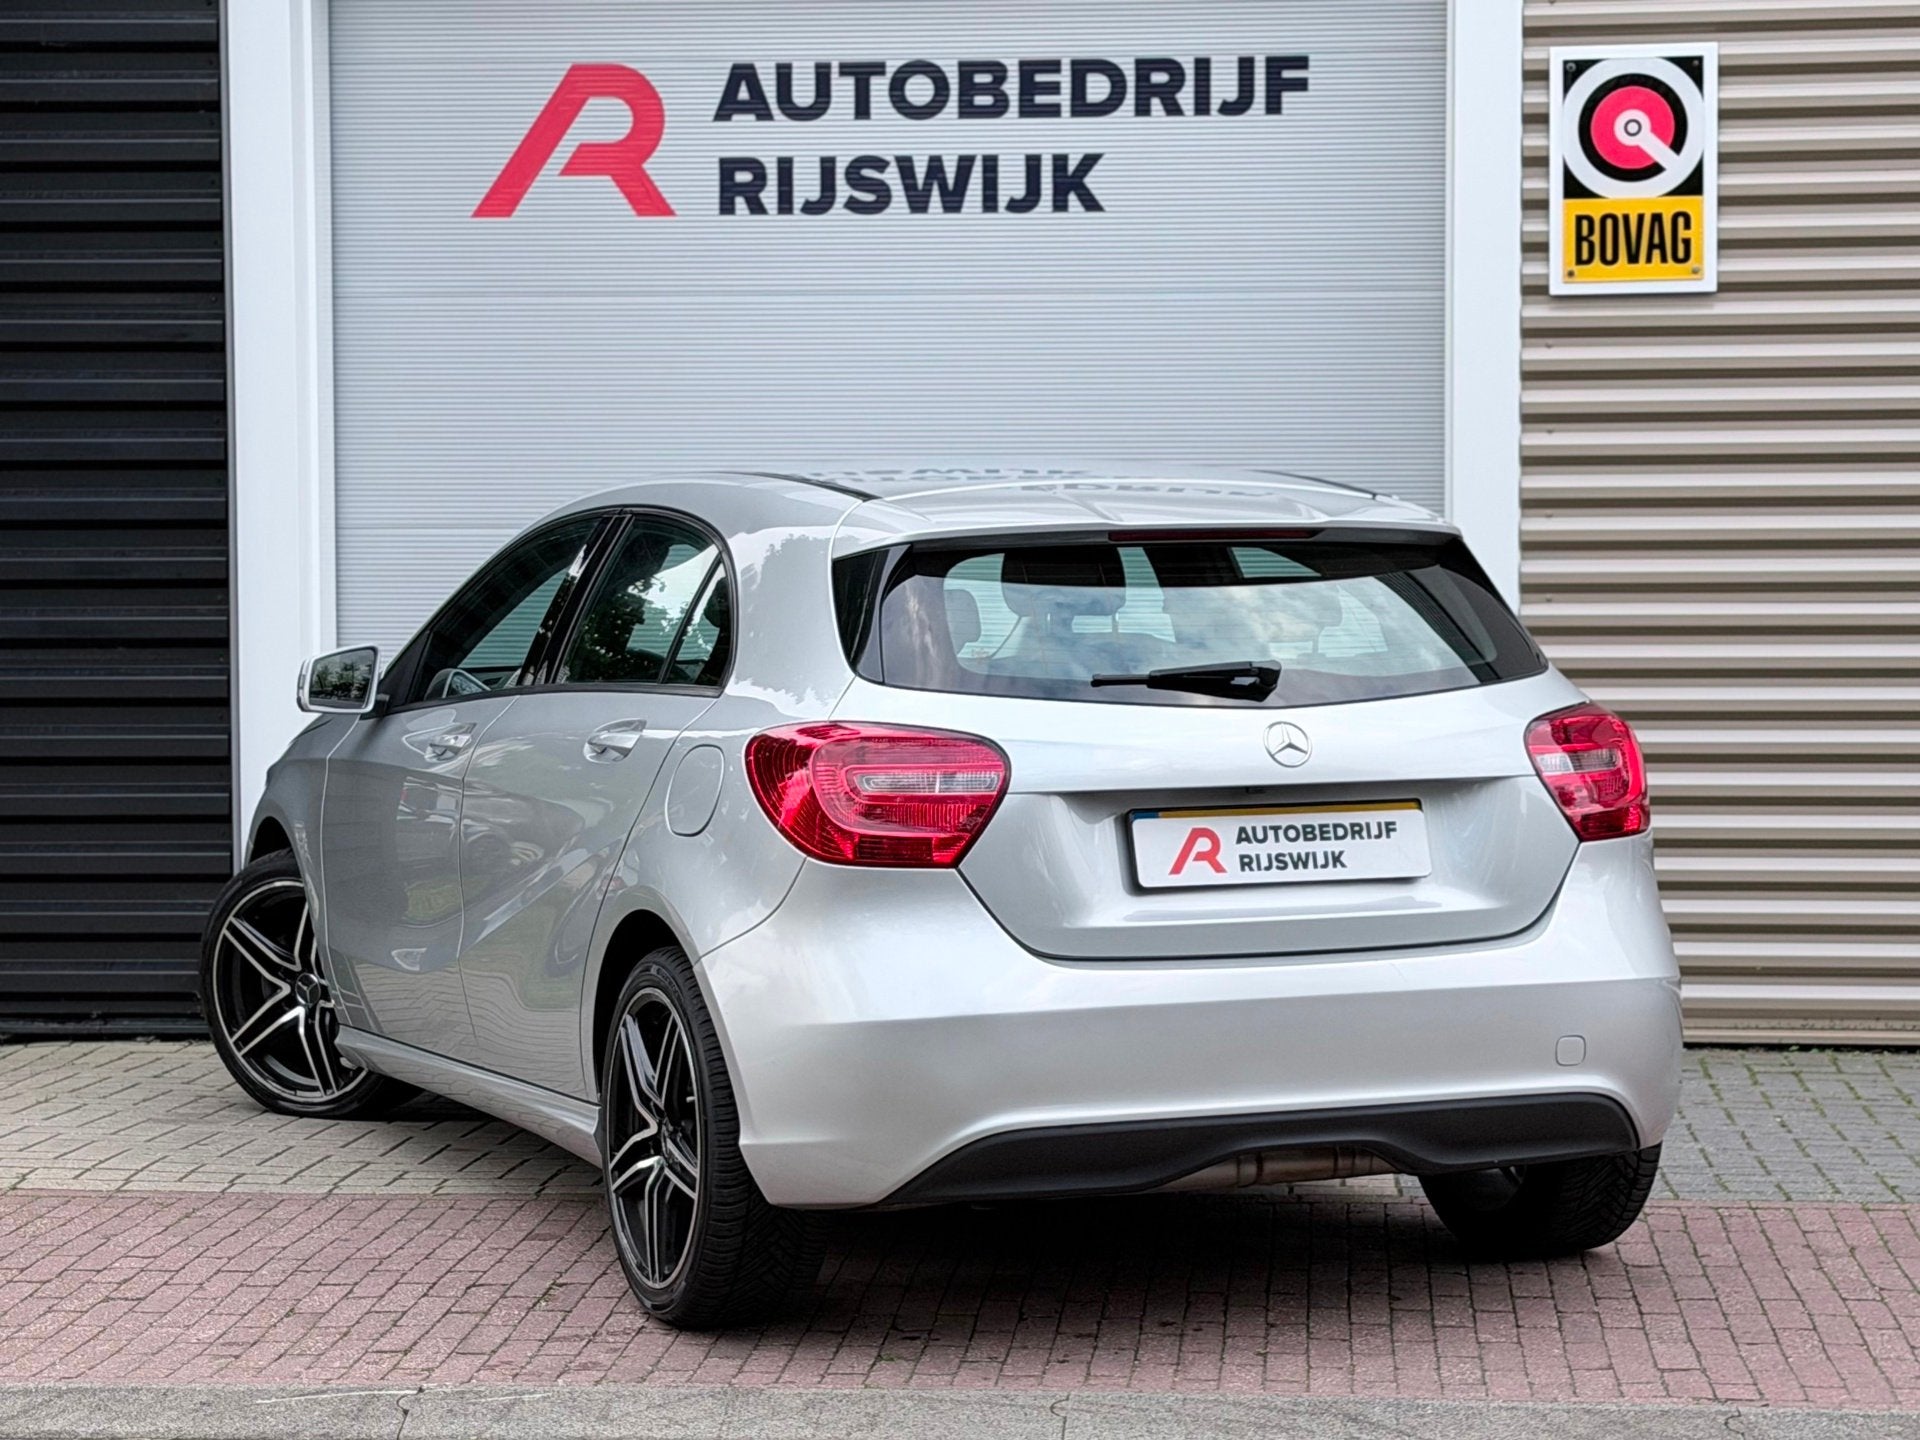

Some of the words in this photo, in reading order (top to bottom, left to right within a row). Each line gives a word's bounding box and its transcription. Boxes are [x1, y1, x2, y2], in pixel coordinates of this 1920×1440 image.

[713, 55, 1310, 122] AUTOBEDRIJF
[718, 153, 1105, 216] RIJSWIJK
[1575, 211, 1692, 266] BOVAG
[1235, 821, 1398, 845] AUTOBEDRIJF
[1239, 850, 1347, 872] RIJSWIJK
